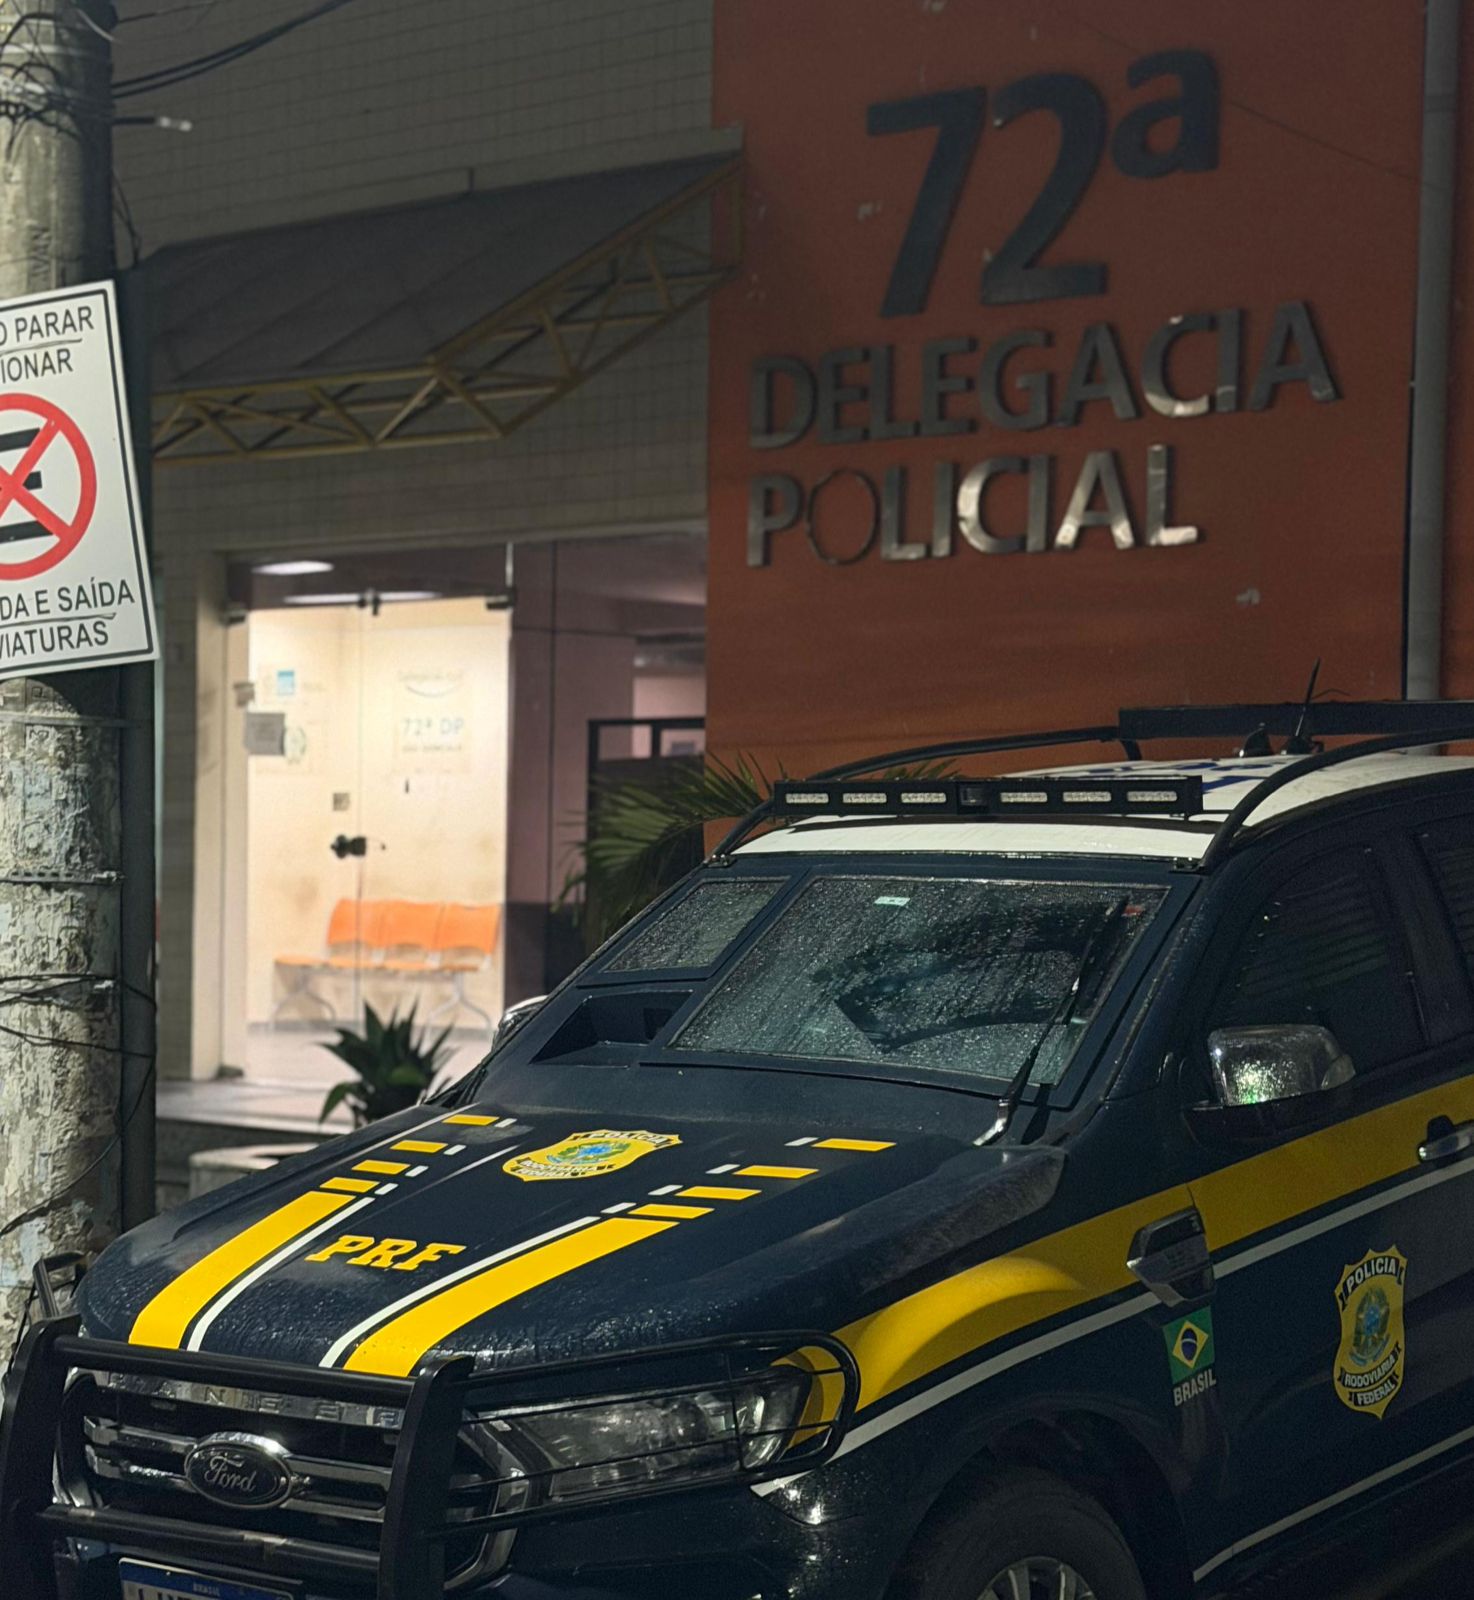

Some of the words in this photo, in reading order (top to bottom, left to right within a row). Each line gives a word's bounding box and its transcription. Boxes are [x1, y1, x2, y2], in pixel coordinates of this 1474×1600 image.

[15, 306, 94, 342] PARAR
[0, 348, 73, 384] IONAR
[749, 300, 1343, 450] DELEGACIA
[747, 445, 1205, 567] POLICIAL
[0, 593, 30, 620] DA
[35, 589, 51, 615] E
[57, 576, 136, 612] SAÍDA
[304, 1235, 467, 1271] PRF
[1173, 1369, 1217, 1407] BRASIL
[1357, 1379, 1396, 1406] FEDERAL
[204, 1454, 257, 1492] Ford
